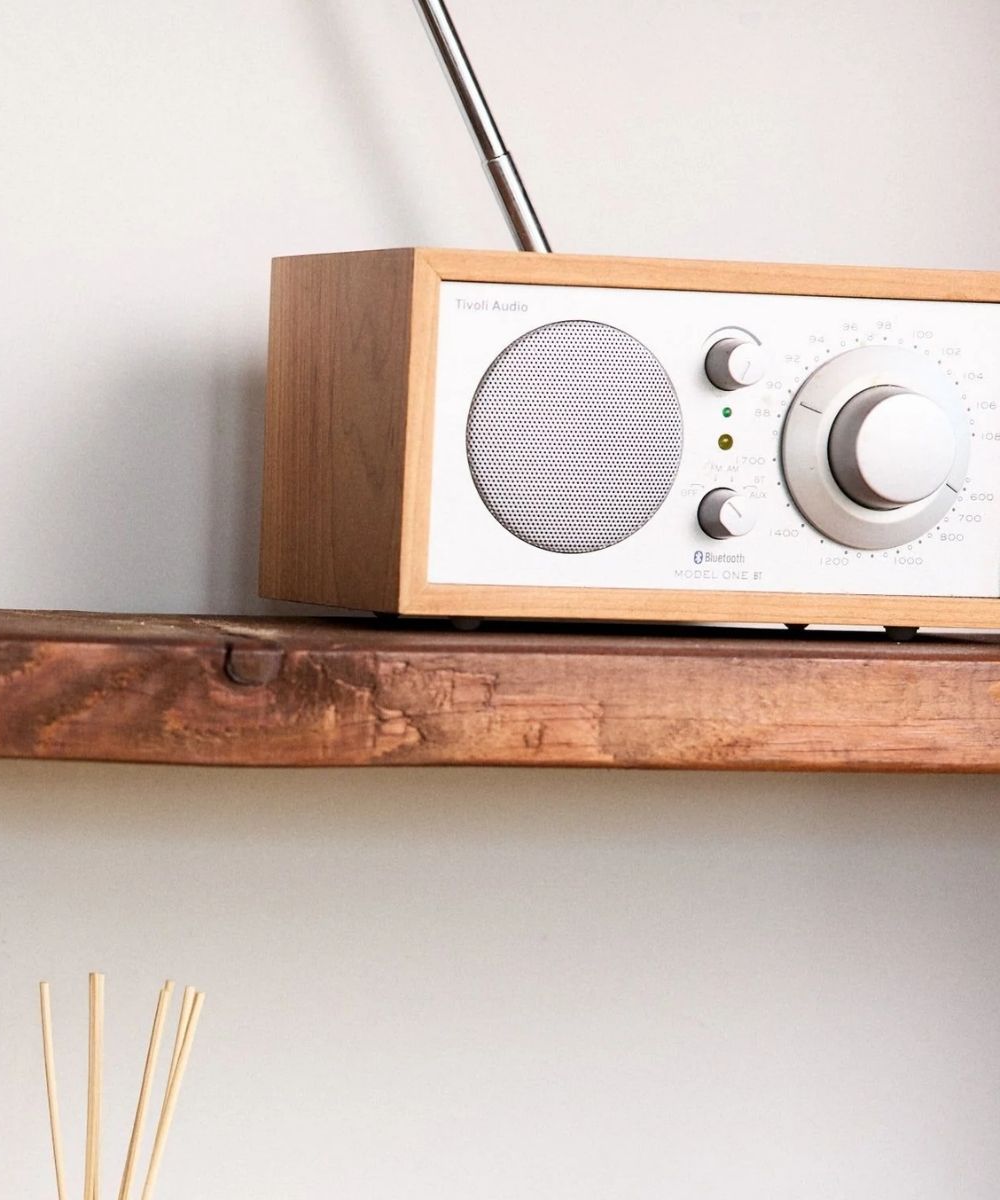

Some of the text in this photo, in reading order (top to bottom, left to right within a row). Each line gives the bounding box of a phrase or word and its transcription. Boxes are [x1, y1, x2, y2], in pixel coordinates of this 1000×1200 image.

[456, 298, 528, 312] Tivoli Audio
[842, 322, 858, 331] 96
[876, 321, 892, 330] 98
[912, 329, 933, 339] 100
[809, 335, 825, 344] 94
[941, 347, 961, 356] 102
[784, 354, 800, 363] 92
[766, 380, 782, 390] 90
[755, 408, 770, 417] 88
[735, 456, 766, 466] 1700
[970, 492, 994, 502] 600
[958, 513, 982, 523] 700
[769, 528, 799, 538] 1400
[940, 532, 964, 542] 800
[704, 551, 745, 564] Bluetooth
[819, 556, 849, 566] 1200
[894, 556, 923, 566] 1000
[674, 569, 763, 581] MODEL ONE BT
